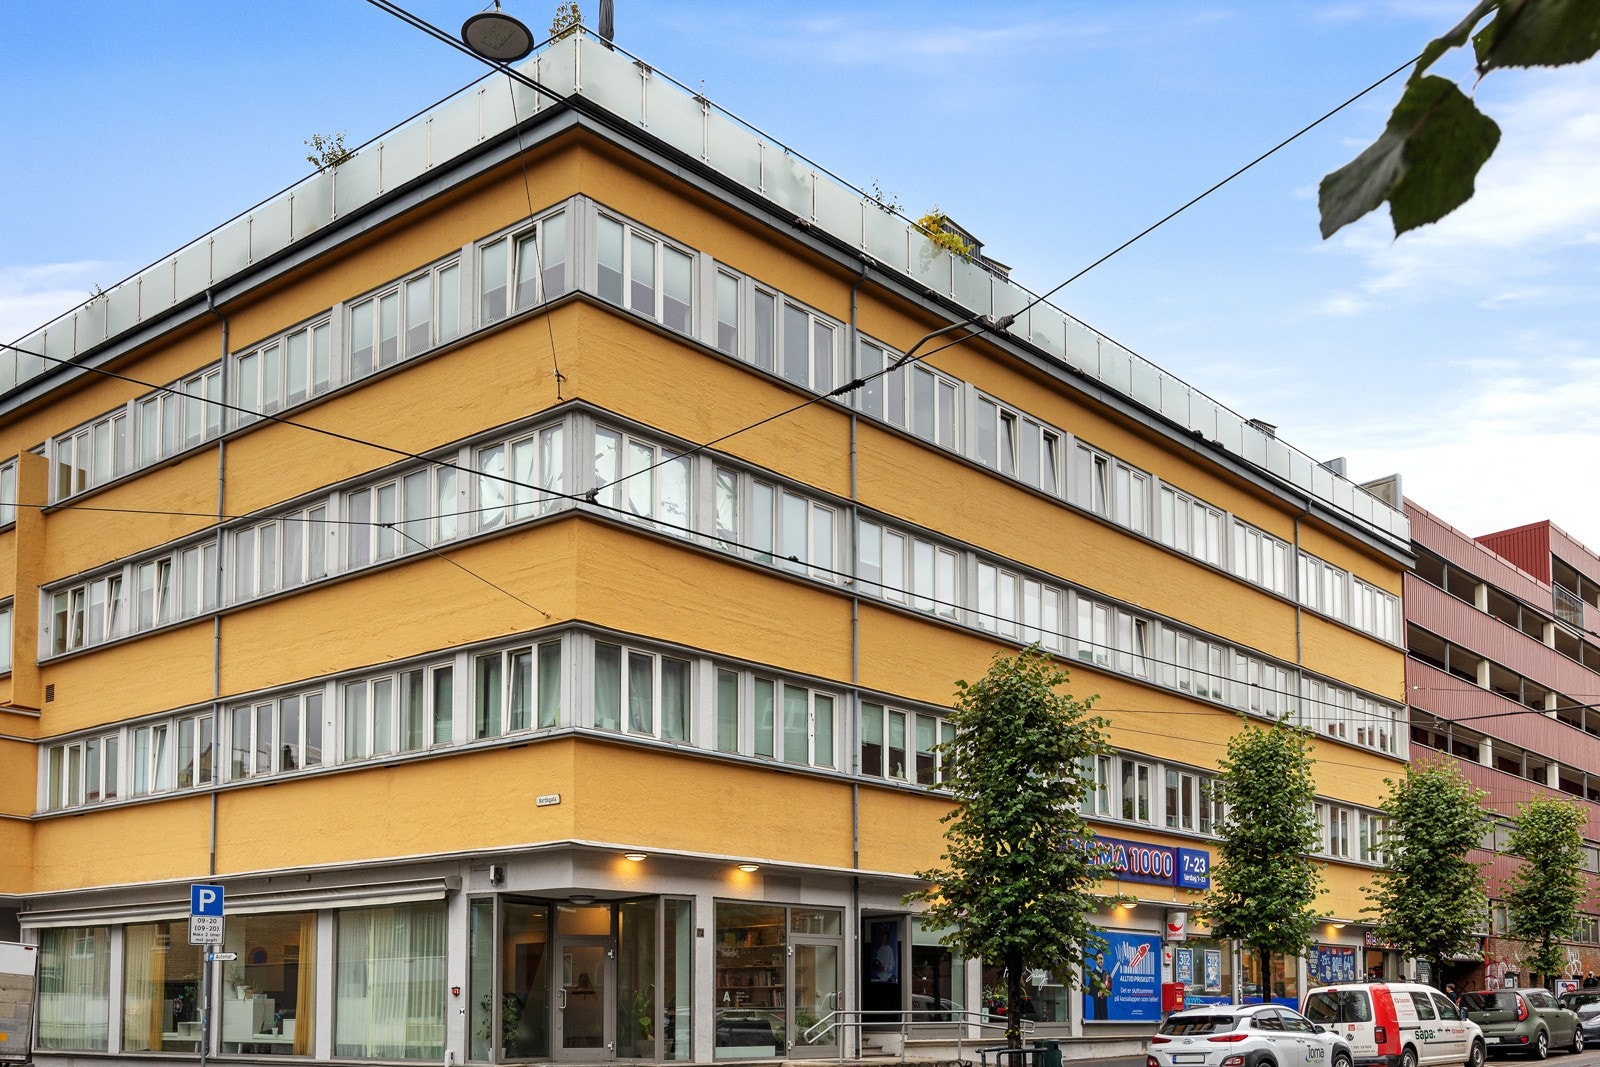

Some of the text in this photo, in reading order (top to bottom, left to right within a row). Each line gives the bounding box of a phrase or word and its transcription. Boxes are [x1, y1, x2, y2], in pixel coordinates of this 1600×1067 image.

[1129, 846, 1173, 877] 1000
[1183, 855, 1206, 873] 7-23
[199, 889, 216, 912] P
[1415, 1029, 1436, 1043] sapa:
[1306, 1044, 1324, 1058] Toma
